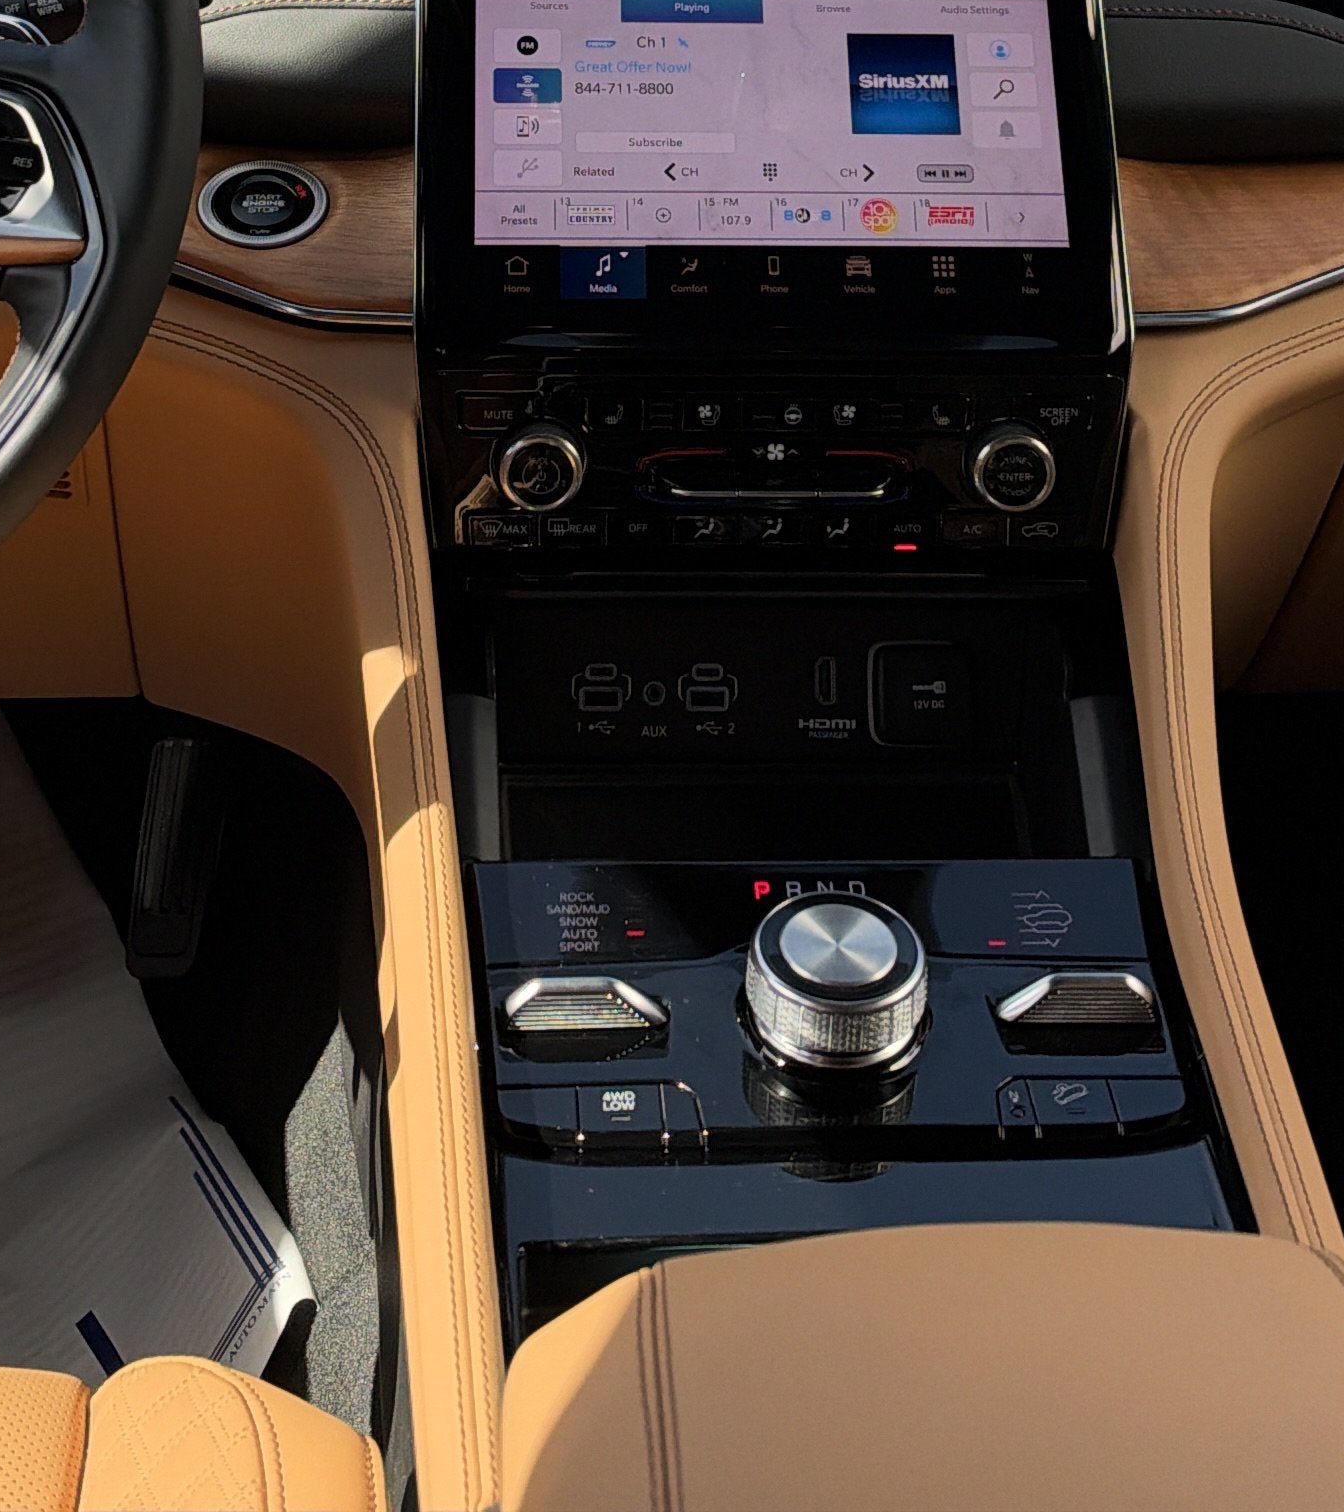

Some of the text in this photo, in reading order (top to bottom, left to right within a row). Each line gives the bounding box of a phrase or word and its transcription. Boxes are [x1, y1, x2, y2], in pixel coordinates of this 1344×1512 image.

[4, 3, 21, 14] OFF
[36, 3, 65, 17] WIPER
[530, 1, 569, 10] Sources
[674, 1, 710, 14] Playing
[816, 4, 851, 13] Browse
[940, 5, 1010, 17] Audio Settings
[520, 41, 535, 50] FM
[636, 36, 657, 49] Ch
[575, 60, 692, 73] Great Offer Now!
[858, 73, 949, 90] SiriusXM
[575, 82, 674, 95] 844-711-8800
[628, 137, 683, 148] Subscribe
[12, 156, 34, 168] RES
[573, 167, 615, 177] Related
[681, 168, 699, 177] CH
[840, 168, 857, 178] CH
[245, 193, 283, 201] START
[560, 197, 571, 206] 13
[632, 197, 644, 206] 14
[704, 198, 739, 206] 15 FM
[241, 200, 287, 208] ENGINE
[776, 198, 787, 207] 16
[848, 198, 859, 207] 17
[919, 199, 931, 207] 18
[512, 204, 526, 214] All
[929, 206, 975, 218] ESPN
[501, 216, 538, 225] Presets
[569, 215, 614, 224] COUNTRY
[721, 216, 752, 225] 107.9
[504, 285, 531, 293] Home
[589, 284, 618, 293] Media
[671, 284, 708, 293] Comfort
[761, 285, 789, 294] Phone
[844, 285, 876, 294] Vehicle
[934, 285, 956, 296] Apps
[1022, 286, 1040, 295] Nav
[483, 410, 514, 420] MUTE
[1039, 408, 1079, 418] SCREEN
[1050, 417, 1071, 427] OFF
[999, 472, 1032, 482] ENTER
[502, 525, 528, 535] MAX
[570, 524, 596, 534] REAR
[628, 523, 649, 533] OFF
[893, 524, 922, 534] AUTO
[962, 524, 982, 535] A/C
[913, 699, 929, 709] 12V
[798, 718, 857, 729] HDMI
[641, 726, 668, 738] AUX
[753, 880, 771, 900] P
[559, 892, 595, 903] ROCK
[546, 904, 611, 916] SAND/MUD
[559, 916, 599, 927] SNOW
[561, 928, 598, 940] AUTO
[559, 940, 601, 953] SPORT
[602, 1090, 636, 1101] 4WD
[602, 1099, 636, 1112] LOW
